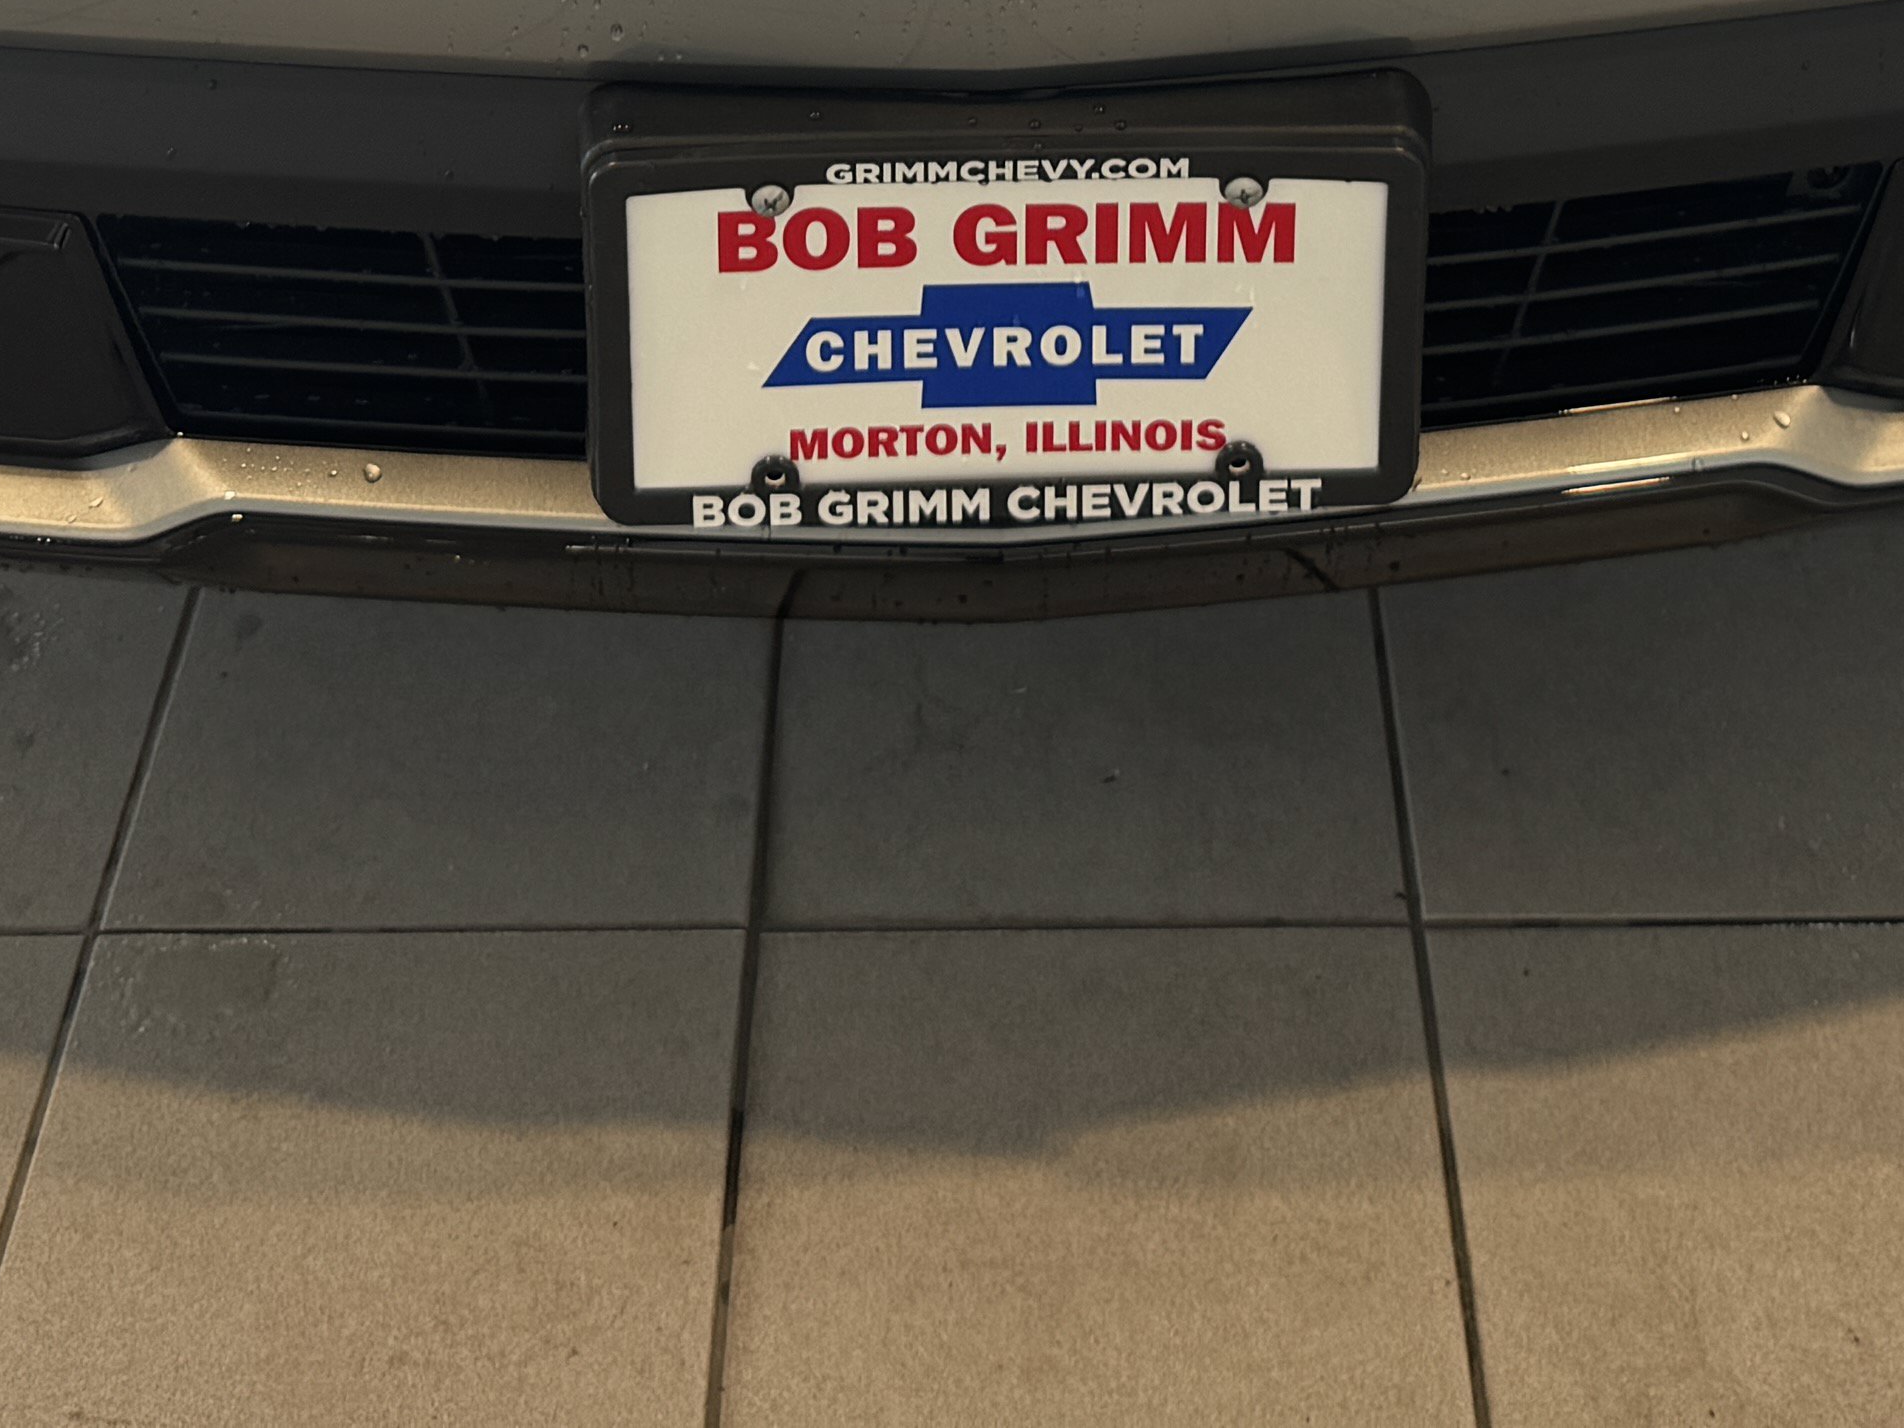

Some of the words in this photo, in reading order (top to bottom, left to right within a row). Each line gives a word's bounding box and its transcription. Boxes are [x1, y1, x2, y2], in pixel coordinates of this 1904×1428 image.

[825, 157, 1190, 184] GRIMMCHEVY.COM
[717, 206, 918, 274] BOB
[953, 202, 1296, 267] GRIMM
[805, 323, 1204, 372] CHEVROLET
[789, 424, 1007, 461] MORTON,
[1025, 419, 1227, 453] ILLINOIS
[692, 492, 802, 528] BOB
[818, 488, 991, 527] GRIMM
[1007, 477, 1323, 522] CHEVROLET
